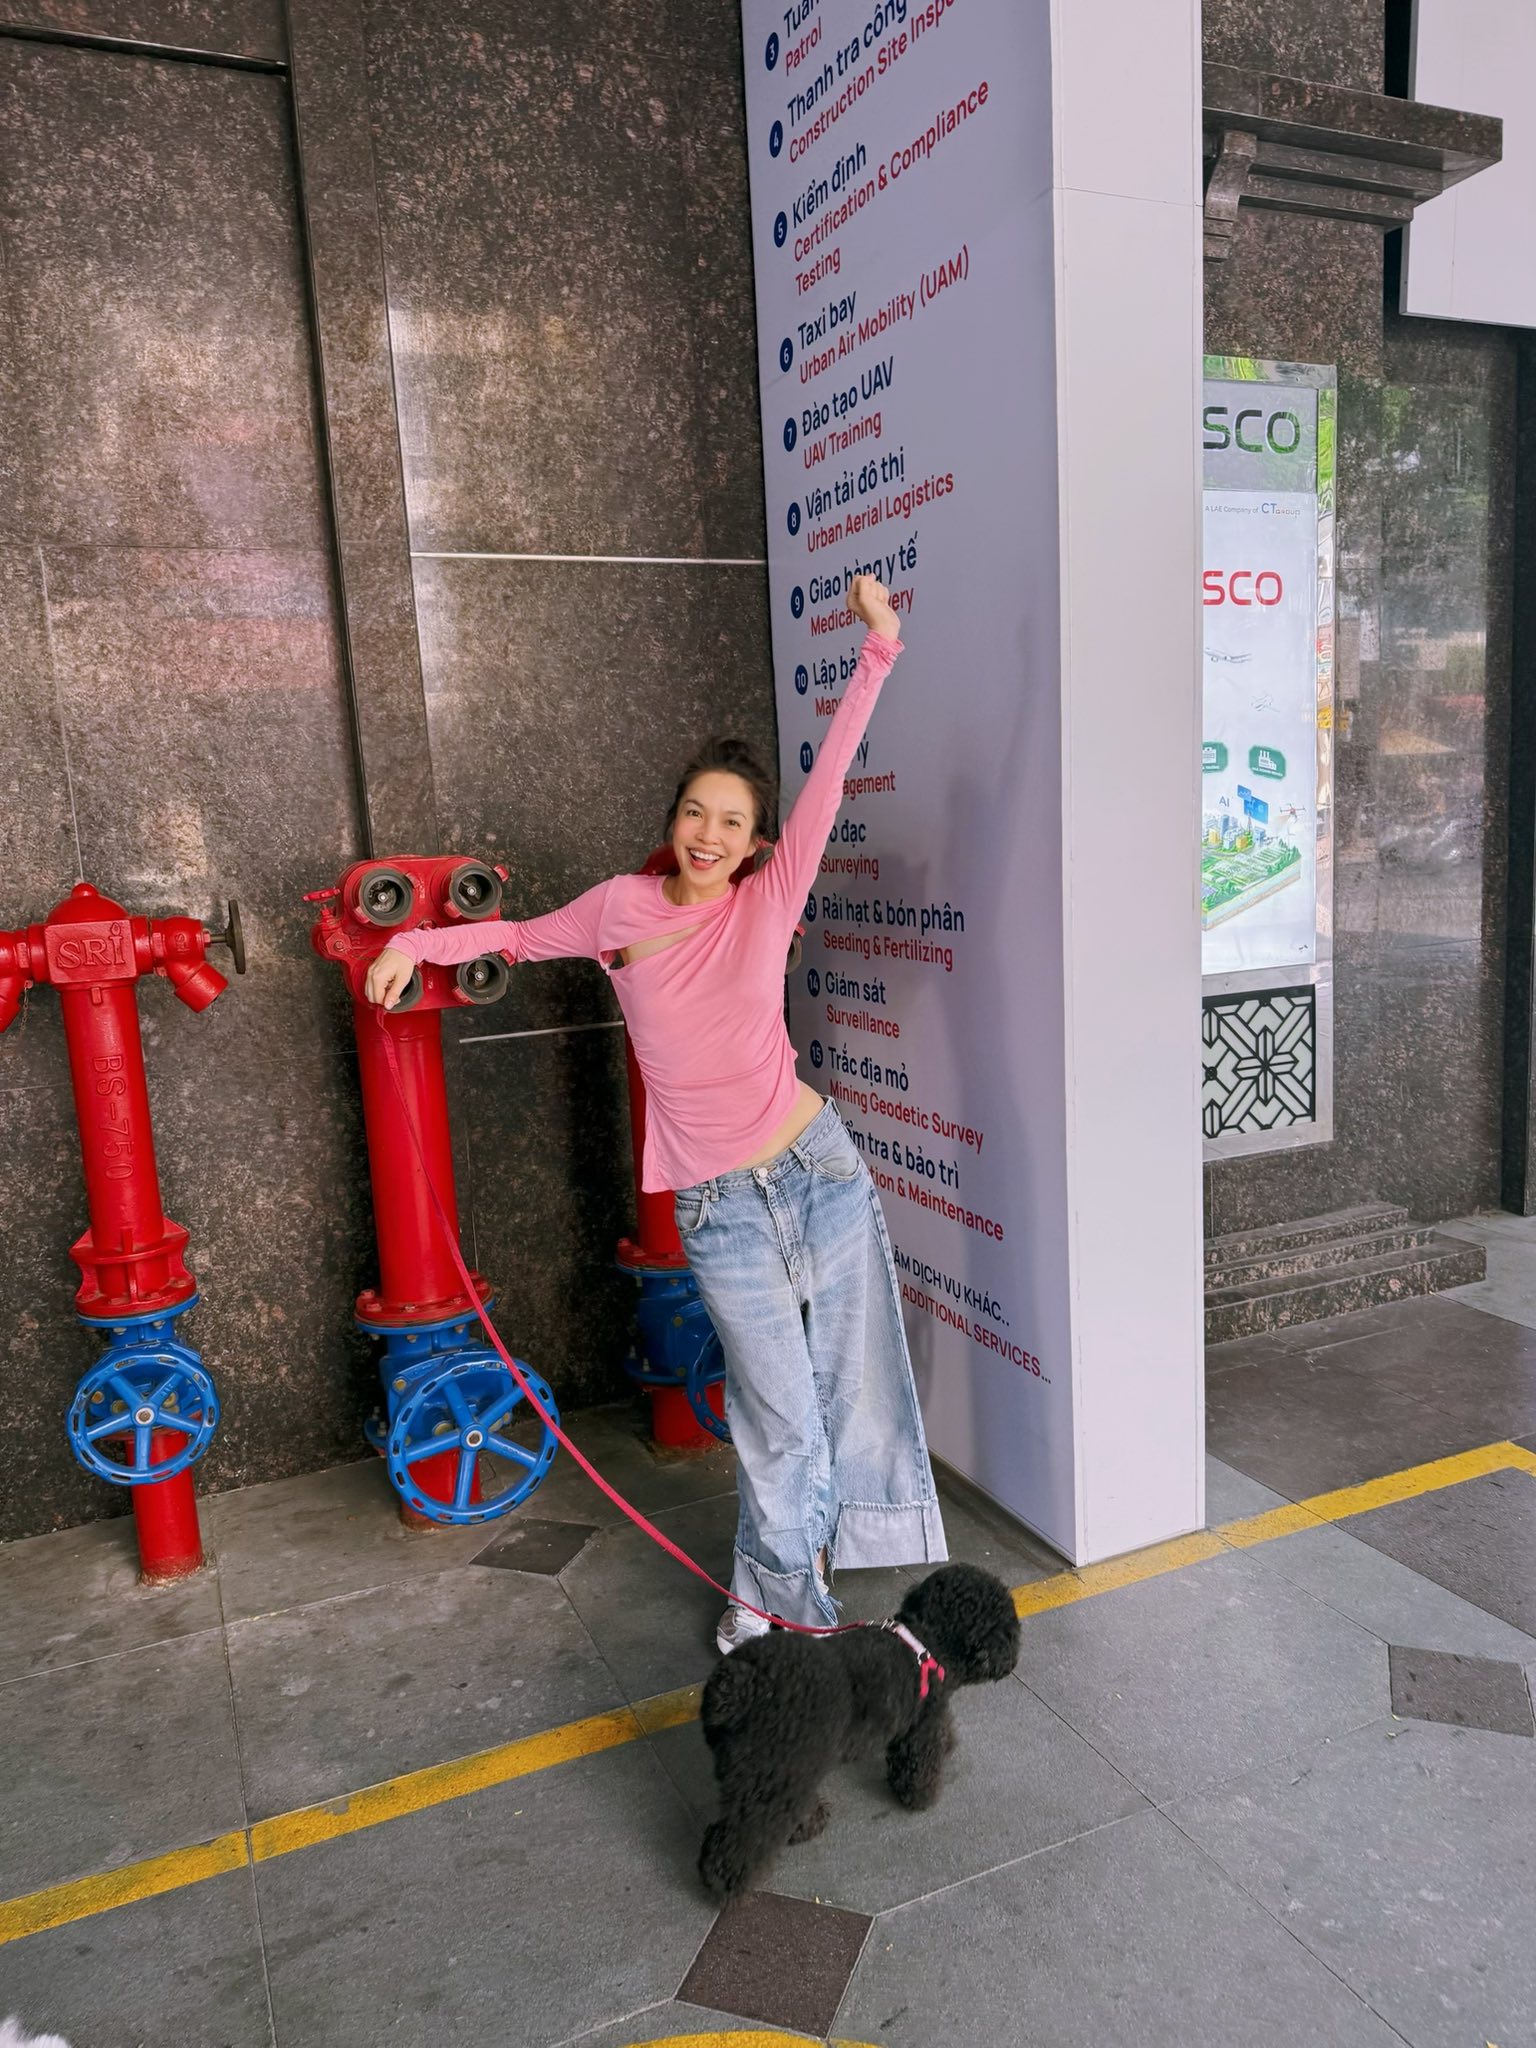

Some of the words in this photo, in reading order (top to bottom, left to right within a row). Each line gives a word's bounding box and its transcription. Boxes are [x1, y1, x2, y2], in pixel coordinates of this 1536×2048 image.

[785, 16, 822, 76] Patrol
[787, 64, 833, 127] Thanh
[836, 37, 860, 76] tra
[864, 0, 907, 48] công
[789, 66, 874, 163] Construction
[877, 32, 908, 75] Site
[793, 179, 829, 229] Kiểm
[831, 143, 866, 192] định
[794, 179, 875, 263] Certification
[877, 164, 888, 191] &
[890, 81, 989, 179] Compliance
[795, 247, 841, 296] Testing
[798, 307, 826, 350] Taxi
[829, 291, 857, 329] bay
[800, 347, 836, 384] Urban
[838, 330, 856, 360] Air
[858, 291, 916, 346] Mobility
[919, 244, 969, 307] (UAM)
[802, 401, 829, 436] Đào
[832, 386, 858, 420] tạo
[861, 356, 894, 400] UAV
[803, 437, 827, 469] UAV
[829, 411, 882, 456] Training
[1202, 406, 1301, 455] SCO
[805, 488, 832, 521] Vận
[834, 471, 855, 506] tải
[858, 460, 878, 495] đô
[880, 446, 905, 483] thị
[1224, 505, 1252, 515] Company
[807, 523, 843, 553] Urban
[845, 499, 882, 537] Aerial
[886, 473, 954, 519] Logistics
[809, 576, 841, 604] Giao
[886, 554, 896, 585] y
[899, 531, 918, 571] tế
[1202, 571, 1283, 606] SCO
[813, 658, 837, 690] Lập
[840, 647, 860, 680] bả
[815, 696, 842, 718] Map
[841, 818, 866, 848] đạc
[820, 853, 879, 881] Surveying
[822, 892, 842, 921] Rải
[846, 898, 870, 928] hạt
[873, 899, 883, 924] &
[887, 898, 920, 927] bón
[921, 902, 965, 936] phân
[824, 930, 870, 960] Seeding
[873, 935, 881, 956] &
[884, 936, 953, 972] Fertilizing
[825, 971, 860, 999] Giám
[863, 977, 887, 1004] sát
[826, 1004, 900, 1038] Surveillance
[828, 1043, 857, 1076] Trắc
[861, 1056, 882, 1086] địa
[885, 1063, 909, 1091] mỏ
[830, 1079, 867, 1114] Mining
[870, 1093, 929, 1130] Geodetic
[932, 1112, 984, 1155] Survey
[867, 1132, 889, 1160] tra
[892, 1141, 903, 1166] &
[906, 1145, 936, 1179] bảo
[939, 1161, 959, 1189] trì
[897, 1177, 906, 1198] &
[909, 1181, 1004, 1241] Maintenance
[913, 1259, 941, 1289] DỊCH
[943, 1275, 961, 1303] VỤ
[902, 1284, 972, 1337] ADDITIONAL
